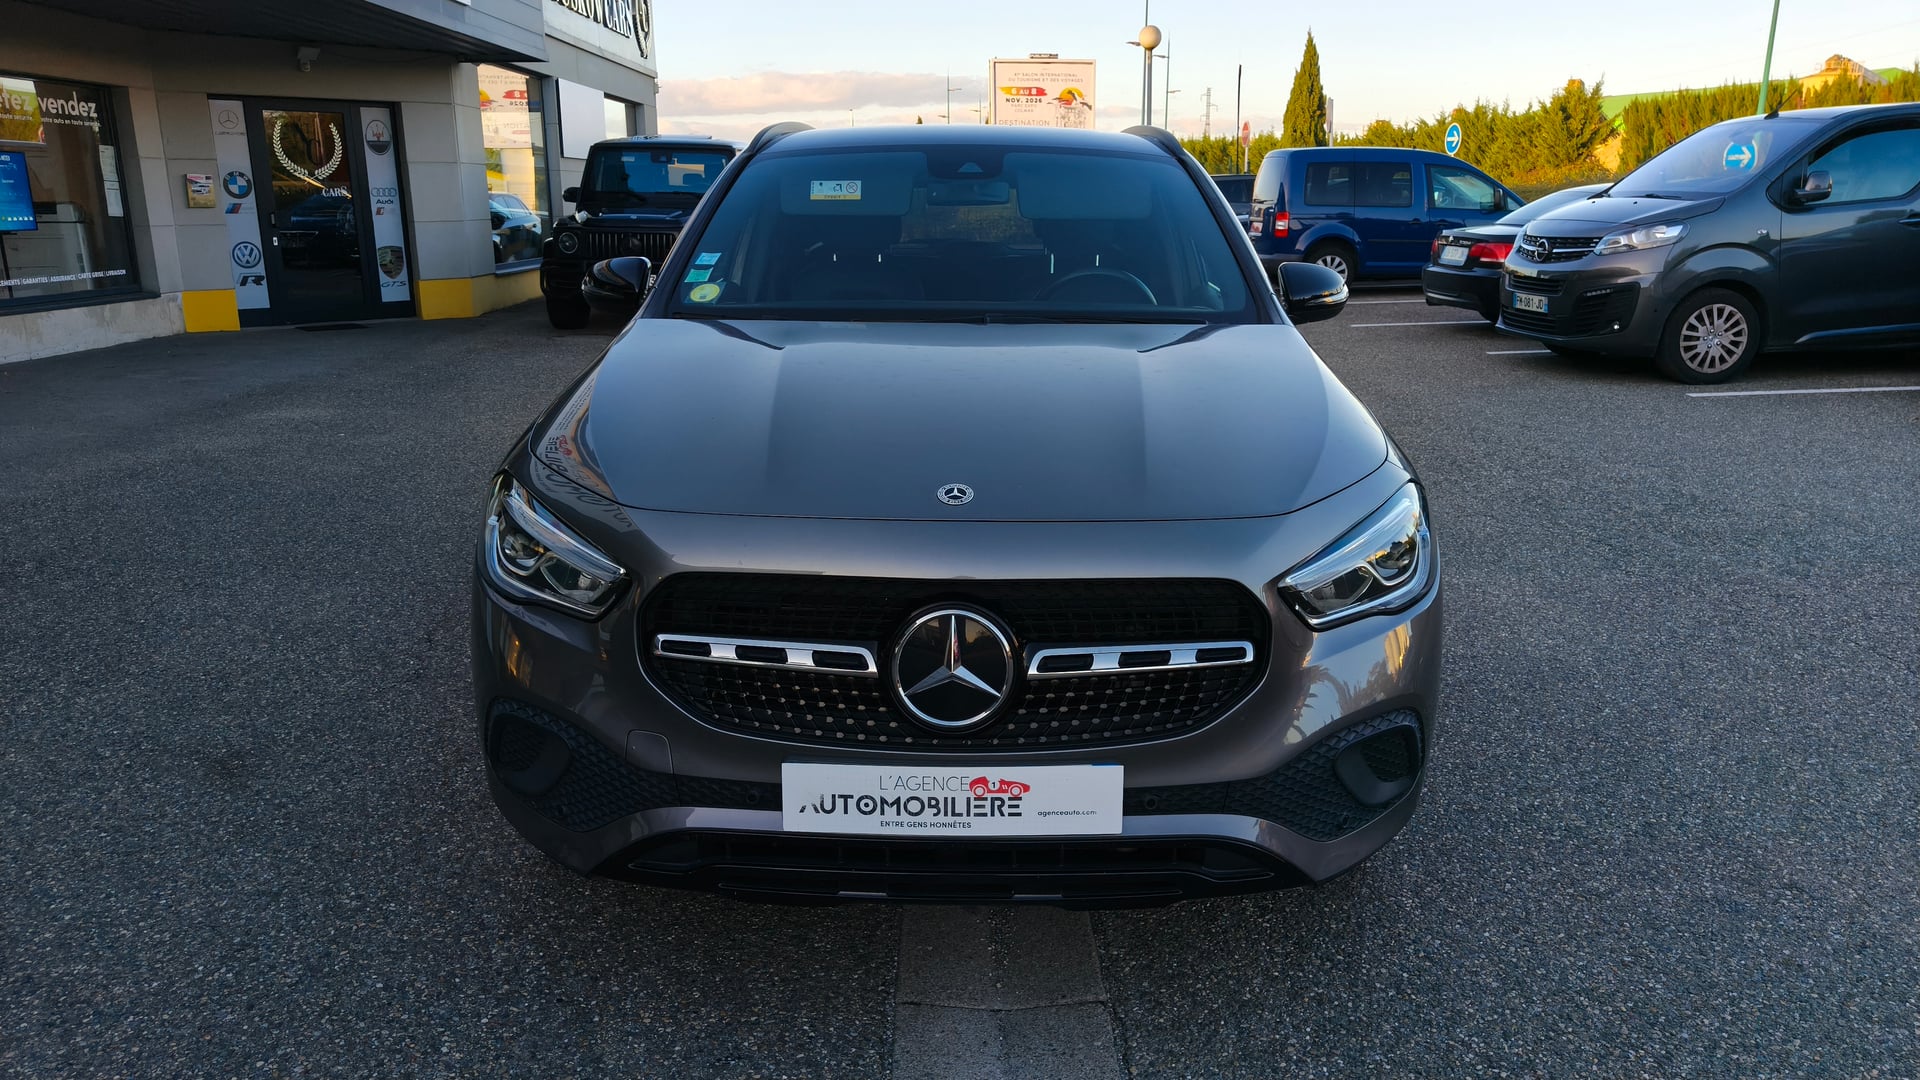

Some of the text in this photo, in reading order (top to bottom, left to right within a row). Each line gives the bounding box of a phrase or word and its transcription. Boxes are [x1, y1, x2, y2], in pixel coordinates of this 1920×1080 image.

[604, 0, 632, 38] CARS
[38, 91, 98, 118] vendez
[322, 186, 348, 197] CARS
[22, 277, 48, 285] GARANTIES
[50, 274, 76, 283] ASSURANCE
[879, 775, 970, 791] L'AGENCE
[1037, 808, 1097, 817] agenceauto.com
[880, 820, 972, 829] ENTRE GENS HONNÊTES
